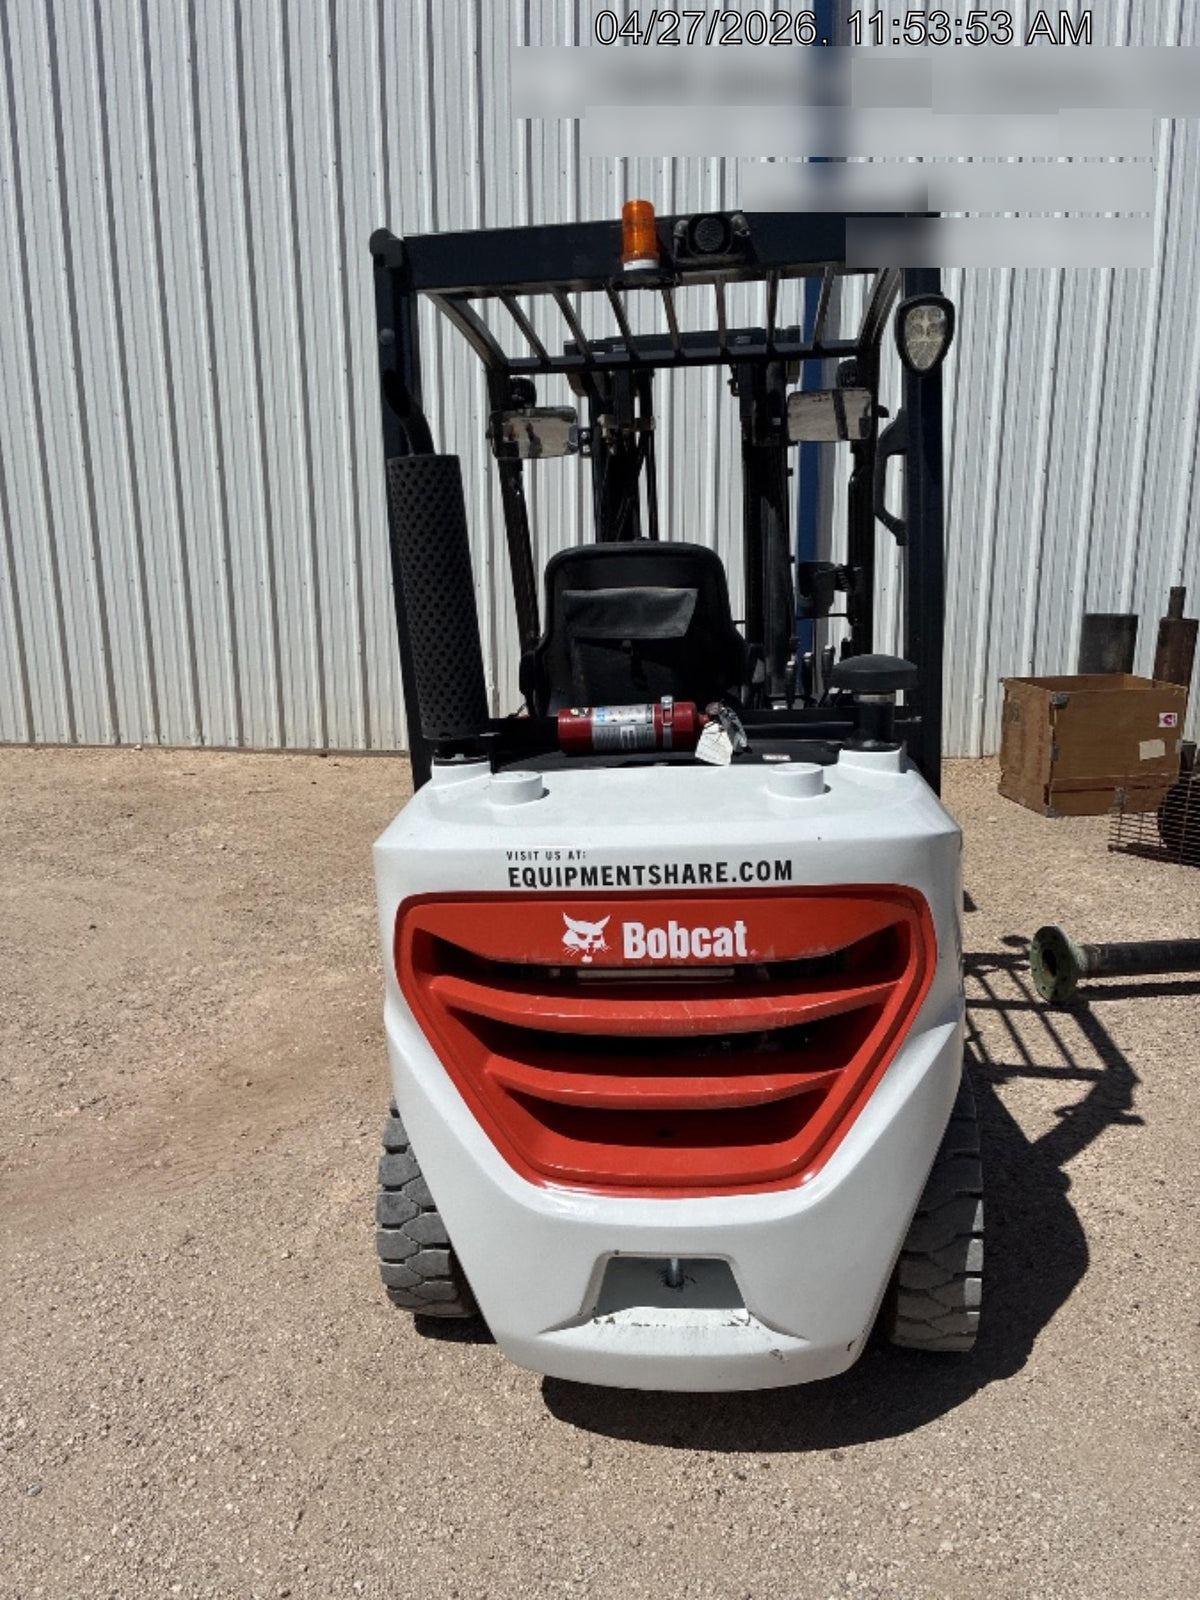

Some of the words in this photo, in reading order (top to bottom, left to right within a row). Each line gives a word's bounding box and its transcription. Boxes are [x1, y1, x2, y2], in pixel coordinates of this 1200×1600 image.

[506, 851, 539, 861] VISIT
[545, 851, 561, 860] US
[568, 850, 587, 860] AT:
[508, 860, 793, 888] EQUIPMENTSHARE.COM
[622, 920, 748, 960] Bobcat
